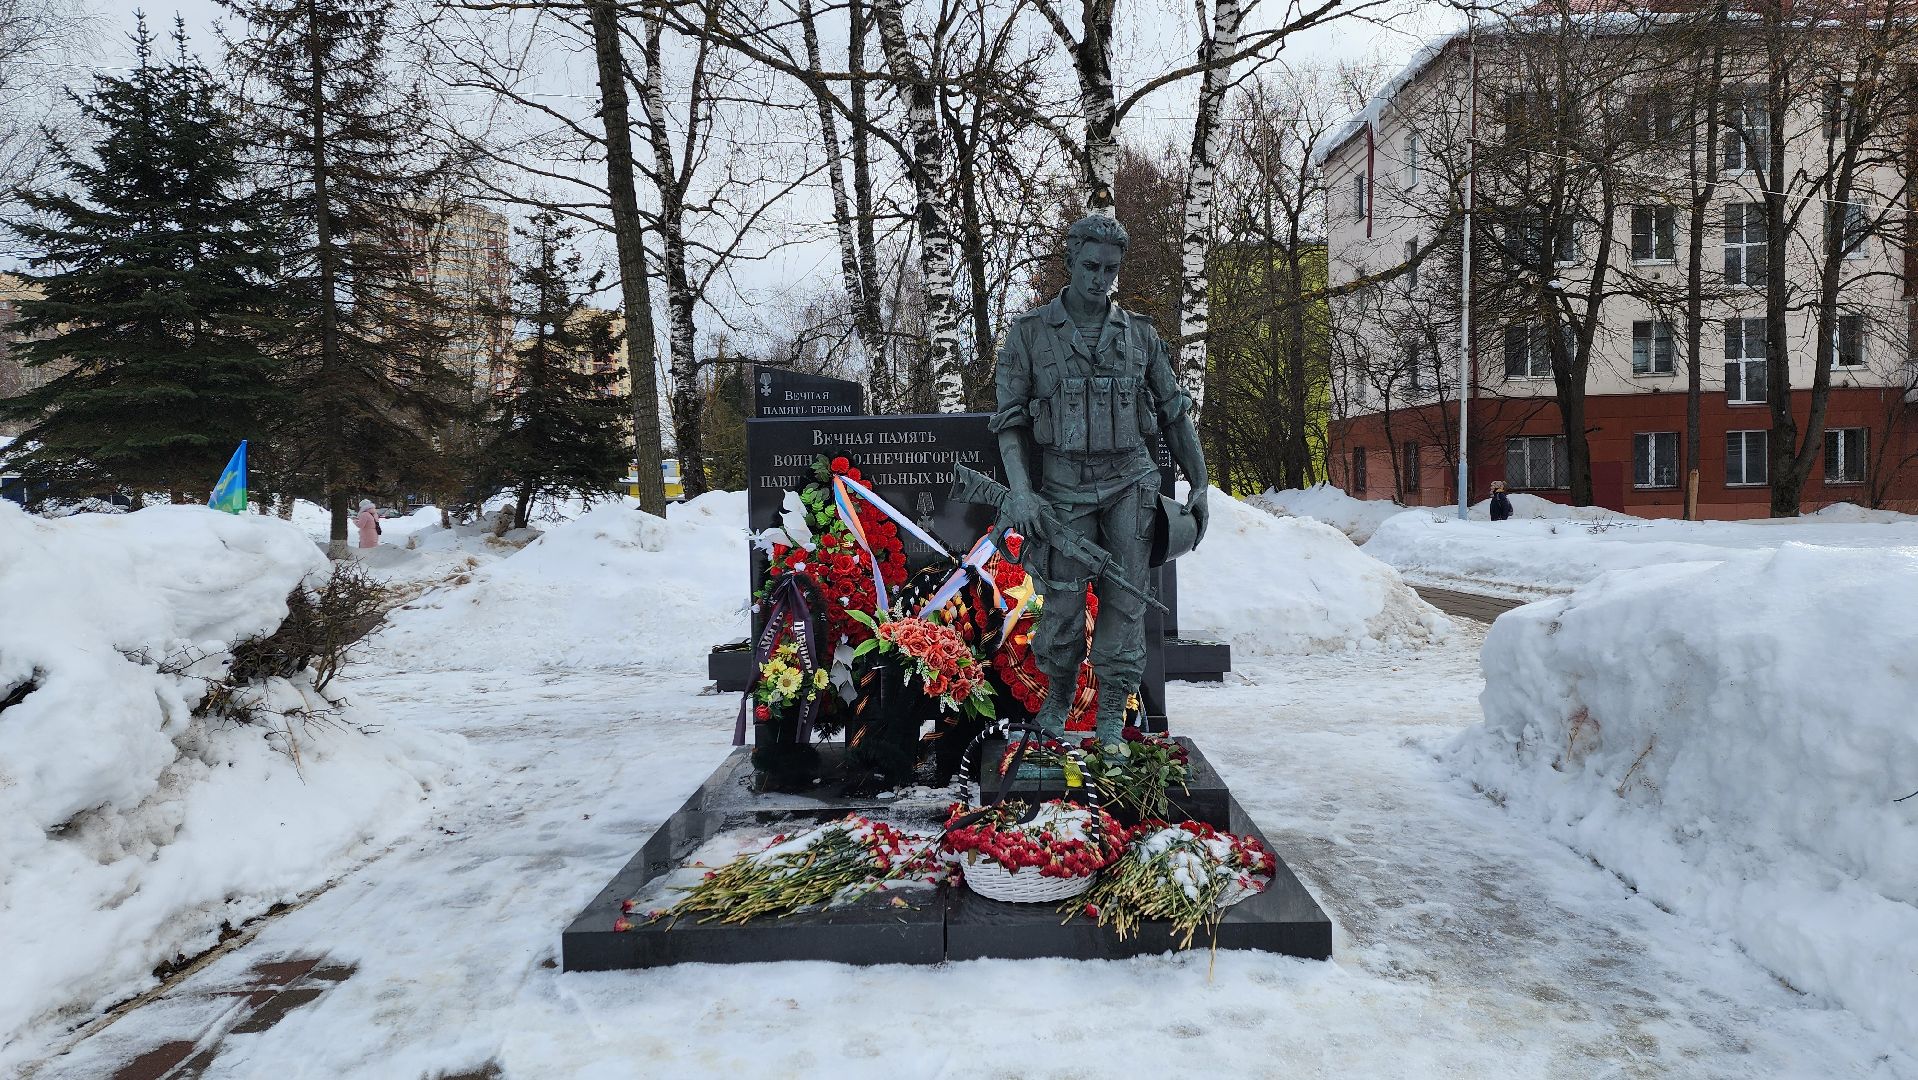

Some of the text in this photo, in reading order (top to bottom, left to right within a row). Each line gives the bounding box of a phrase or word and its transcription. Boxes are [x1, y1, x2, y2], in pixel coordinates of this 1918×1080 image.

[762, 404, 852, 415] ПАМЯТЬ ГЕРОЯМ
[878, 431, 937, 444] ПАМЯТЬ
[773, 454, 813, 467] ВОИН
